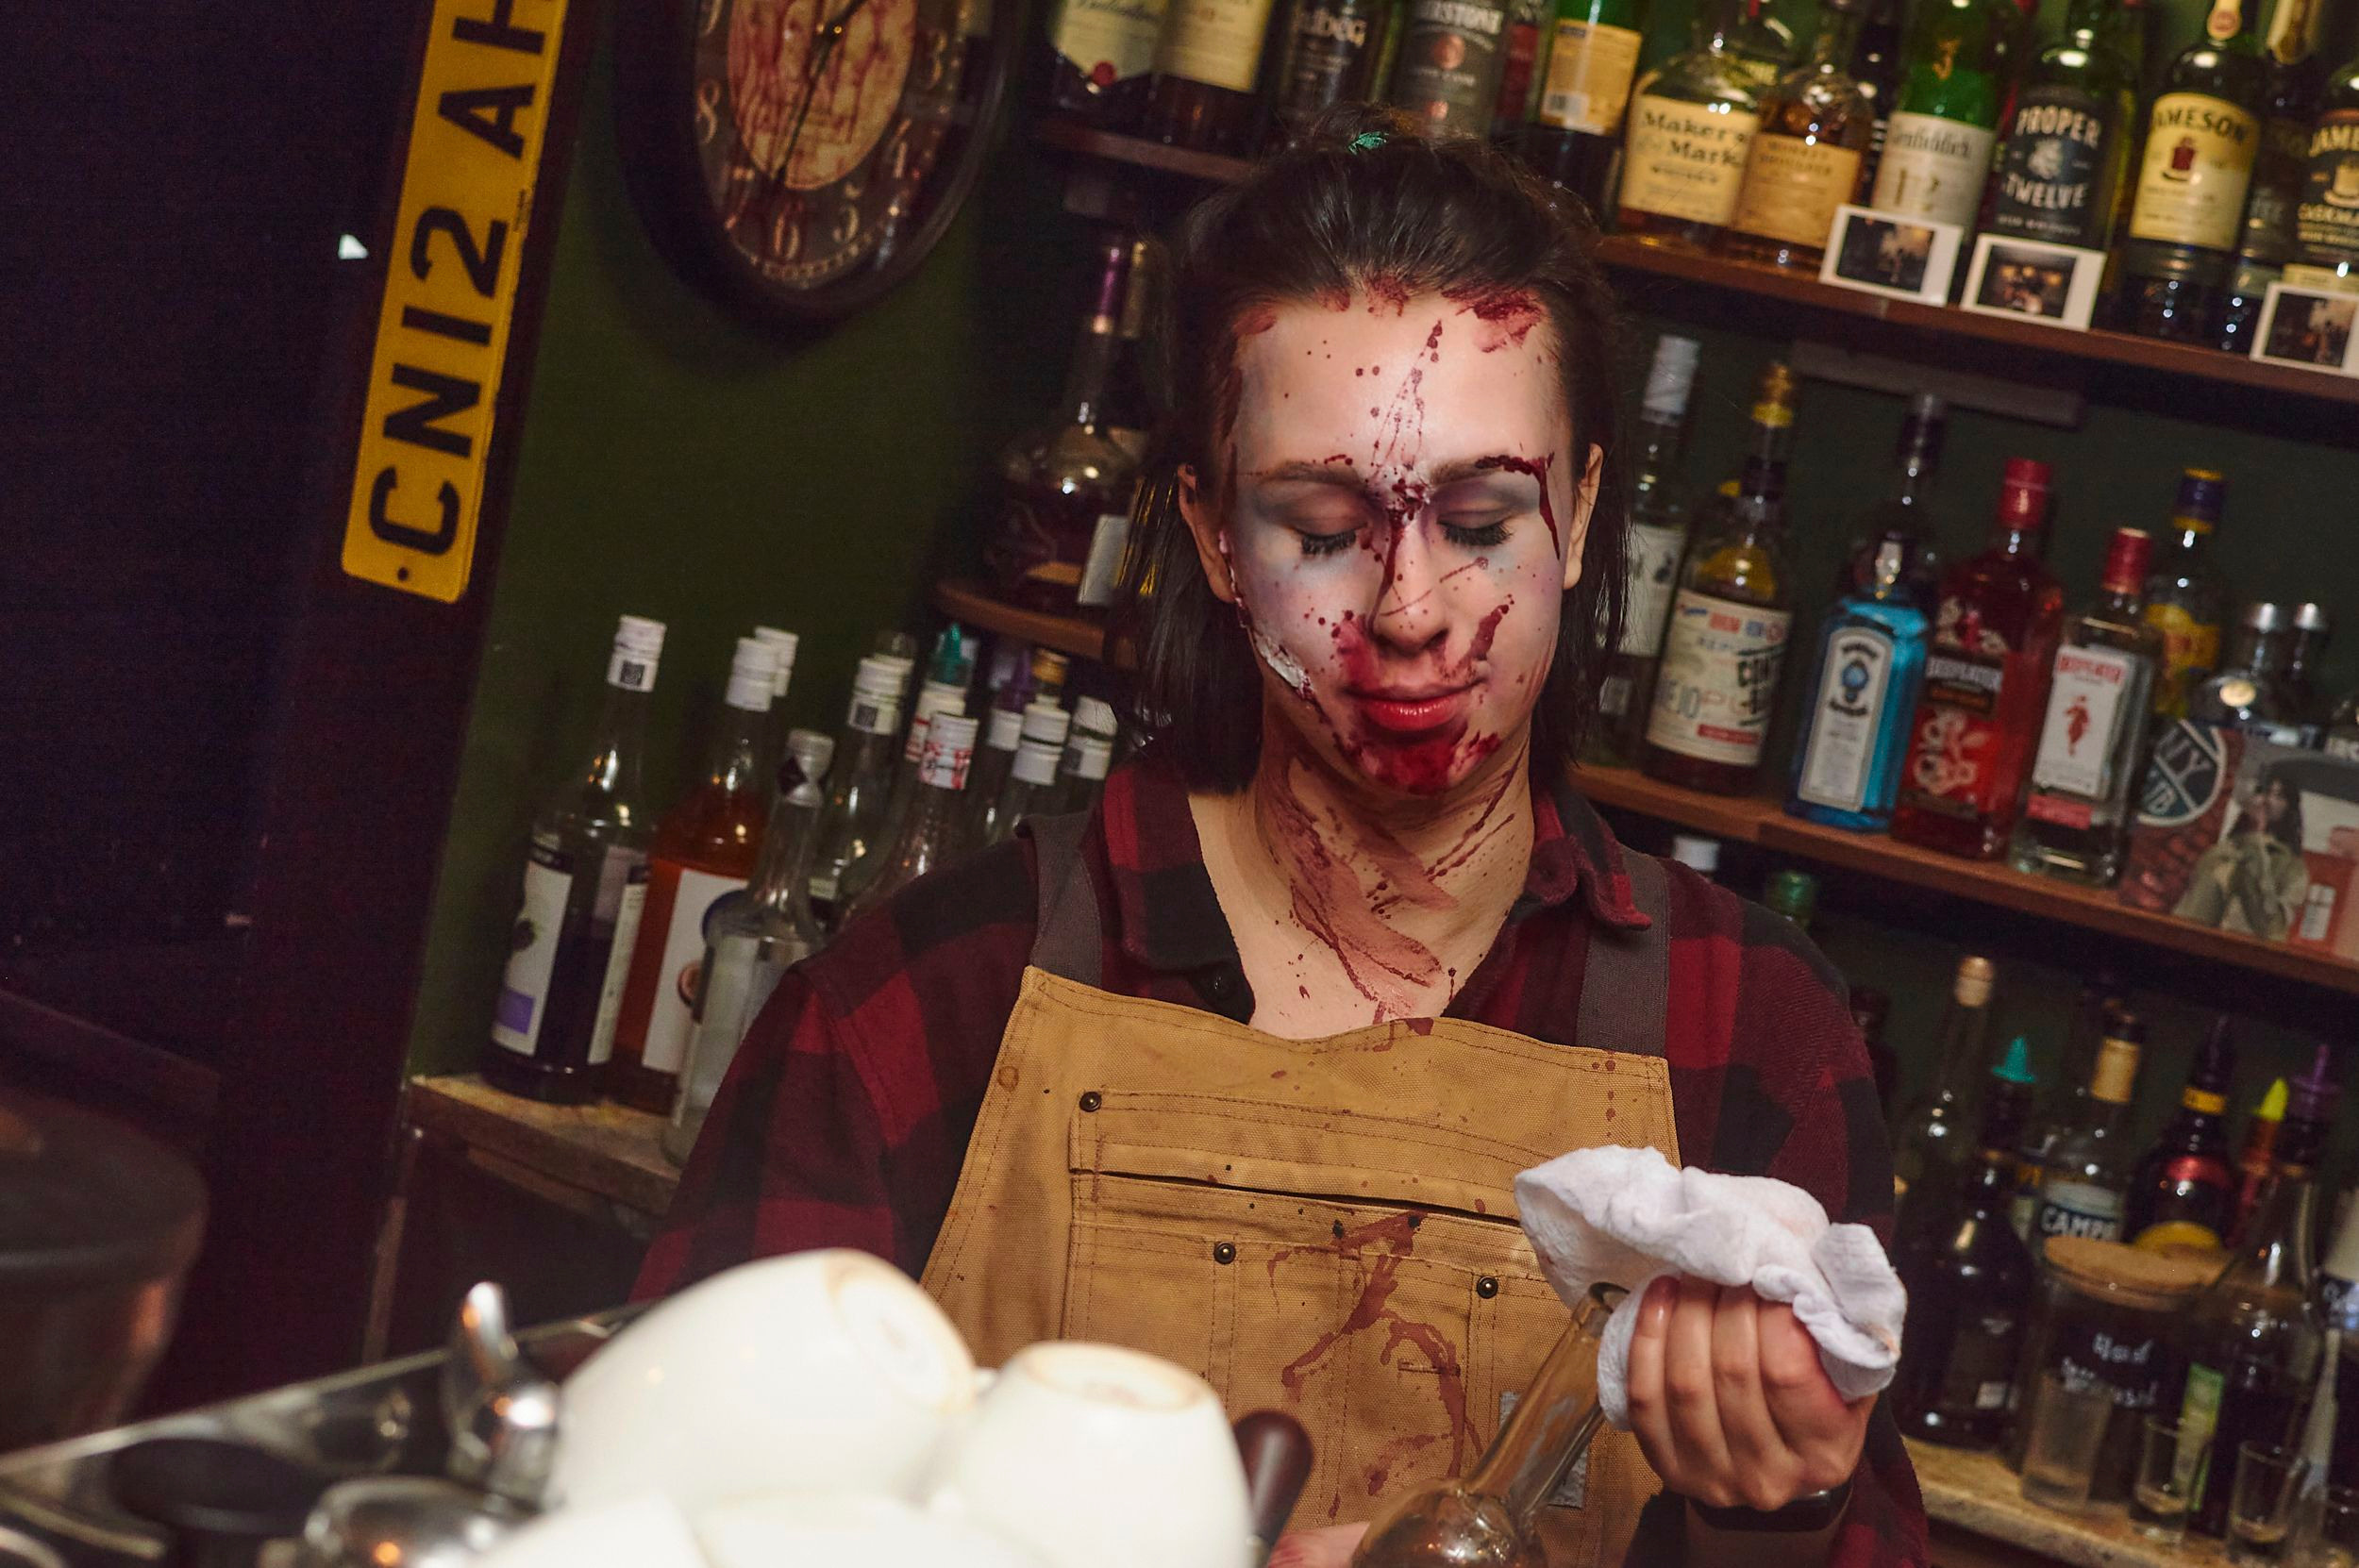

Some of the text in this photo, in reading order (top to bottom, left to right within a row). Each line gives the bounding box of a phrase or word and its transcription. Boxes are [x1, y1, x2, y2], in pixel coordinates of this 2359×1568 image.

[2015, 104, 2101, 149] PROPER
[1669, 140, 1742, 166] Mark
[2001, 171, 2089, 209] TWELVE
